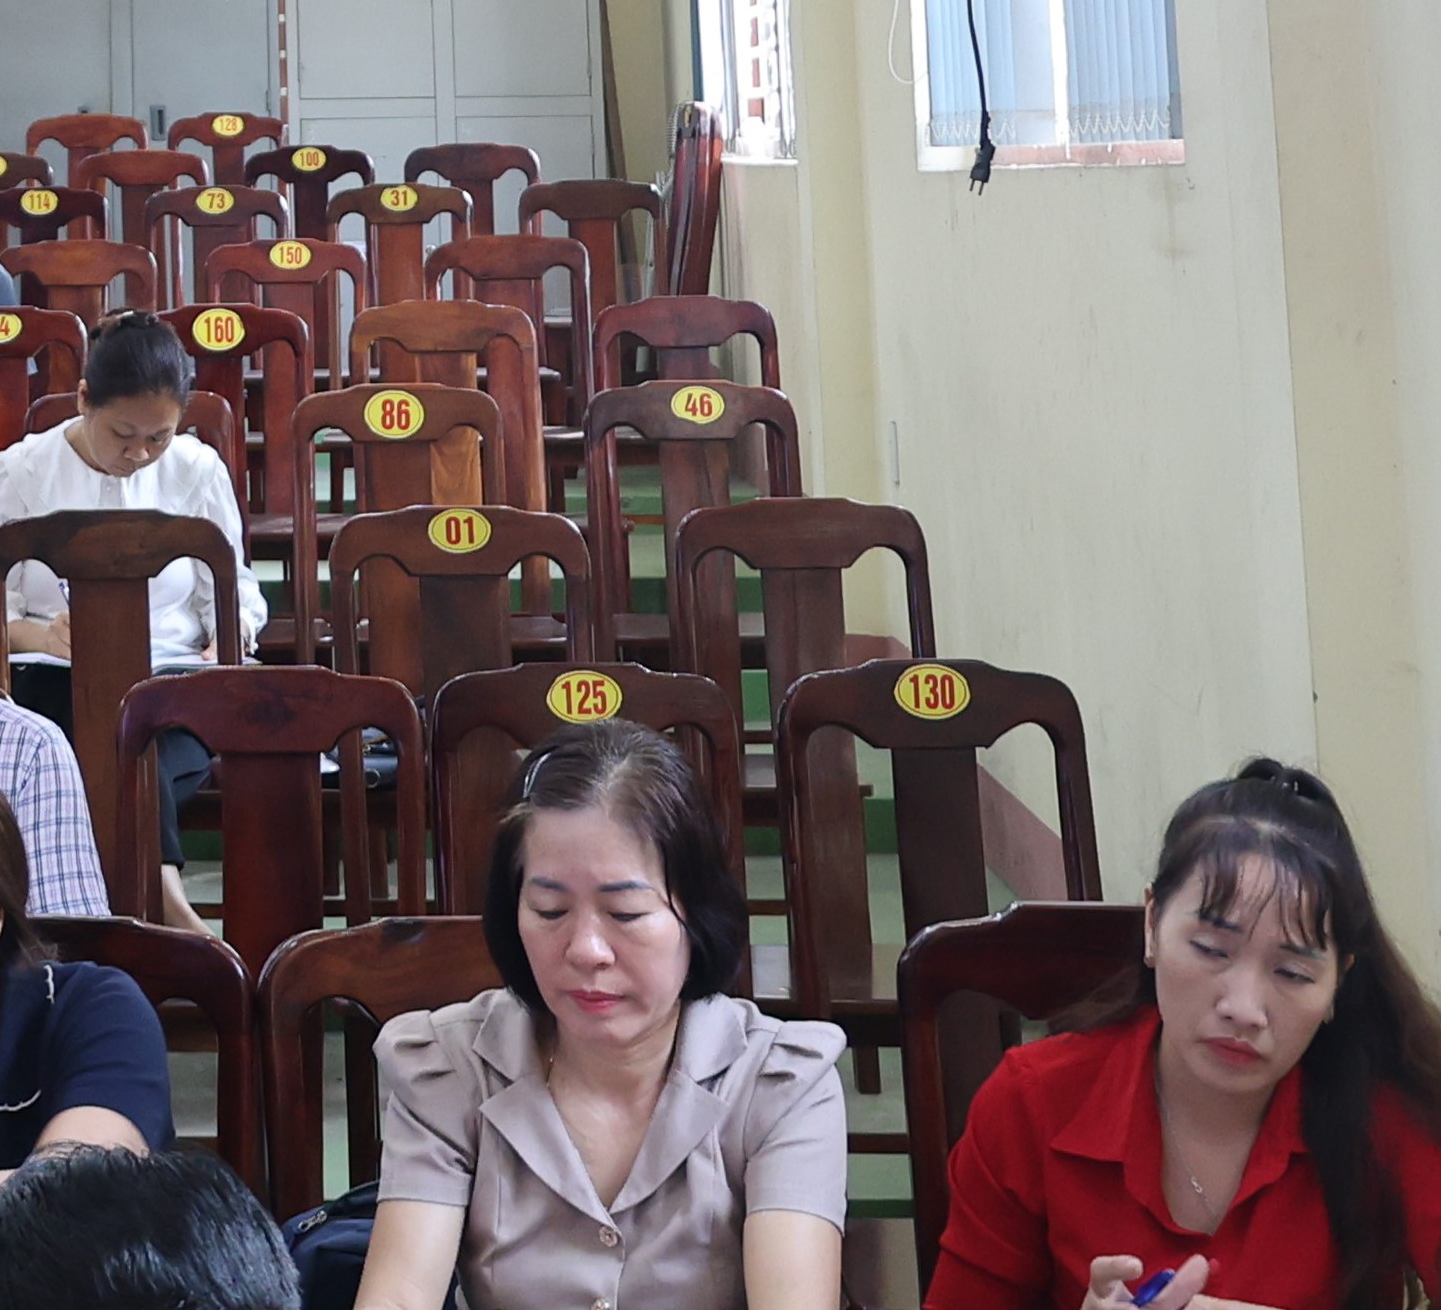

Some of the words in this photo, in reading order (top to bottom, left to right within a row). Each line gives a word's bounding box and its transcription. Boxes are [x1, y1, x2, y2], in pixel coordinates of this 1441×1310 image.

[300, 151, 319, 166] 100
[29, 193, 50, 211] 114
[207, 193, 226, 209] 73
[391, 190, 407, 206] 31
[278, 246, 302, 265] 150
[204, 317, 234, 343] 160
[381, 399, 410, 430] 86
[685, 393, 712, 417] 46
[445, 516, 474, 545] 01
[561, 680, 607, 715] 125
[908, 673, 955, 712] 130
